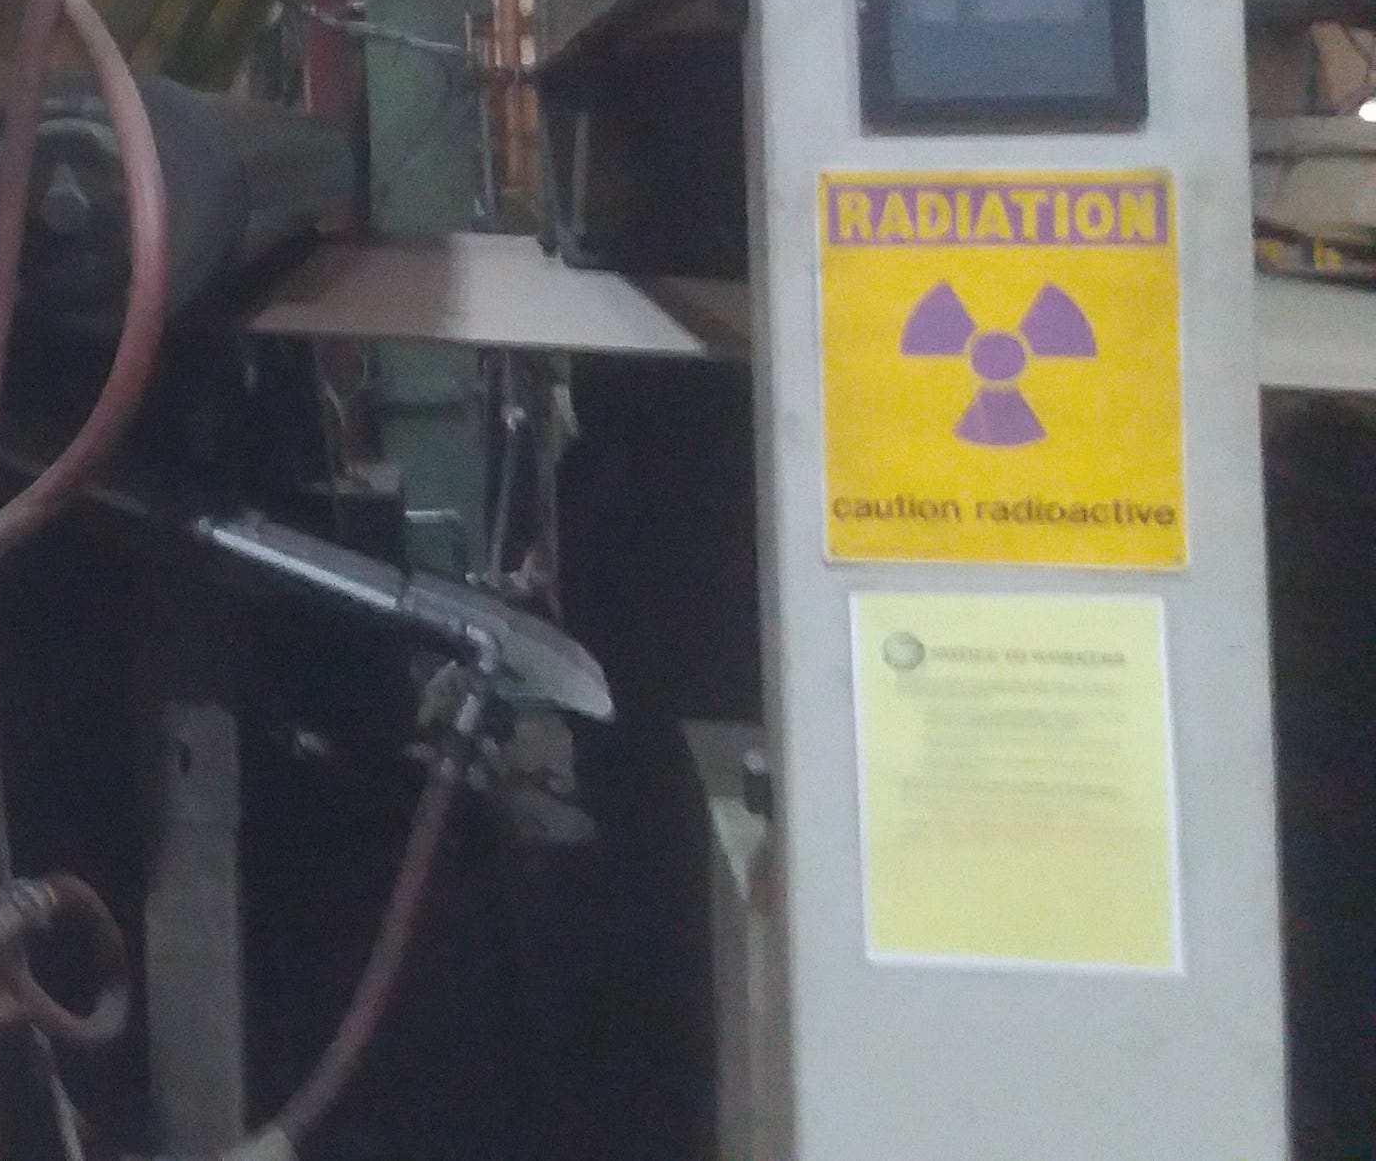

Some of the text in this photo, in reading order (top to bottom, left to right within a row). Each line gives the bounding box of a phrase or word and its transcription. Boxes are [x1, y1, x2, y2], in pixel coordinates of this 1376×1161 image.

[838, 190, 1157, 240] RADIATION
[833, 494, 1177, 526] caution radioactive
